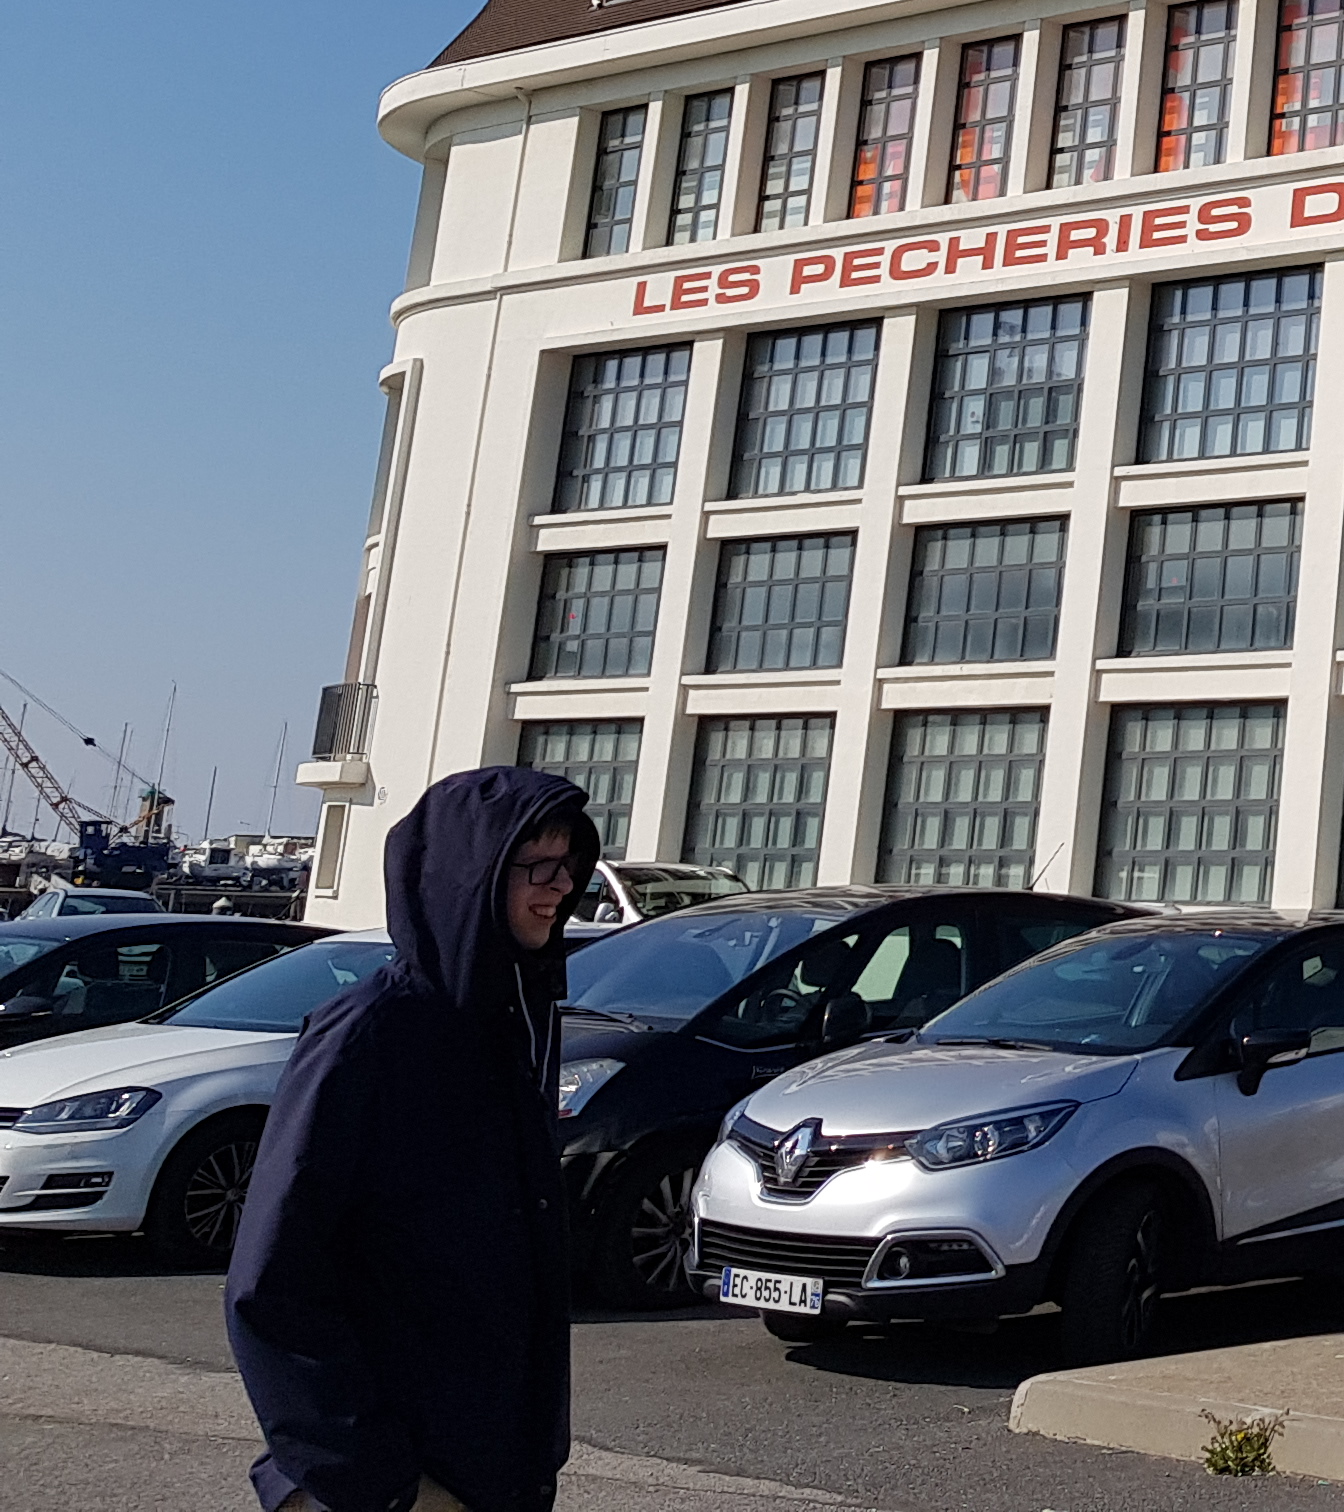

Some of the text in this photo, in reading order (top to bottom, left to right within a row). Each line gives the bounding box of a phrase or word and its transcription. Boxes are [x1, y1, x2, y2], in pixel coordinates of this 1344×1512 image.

[633, 264, 761, 316] LES
[790, 196, 1252, 295] PECHERIES
[731, 1273, 807, 1308] EC-855-LA
